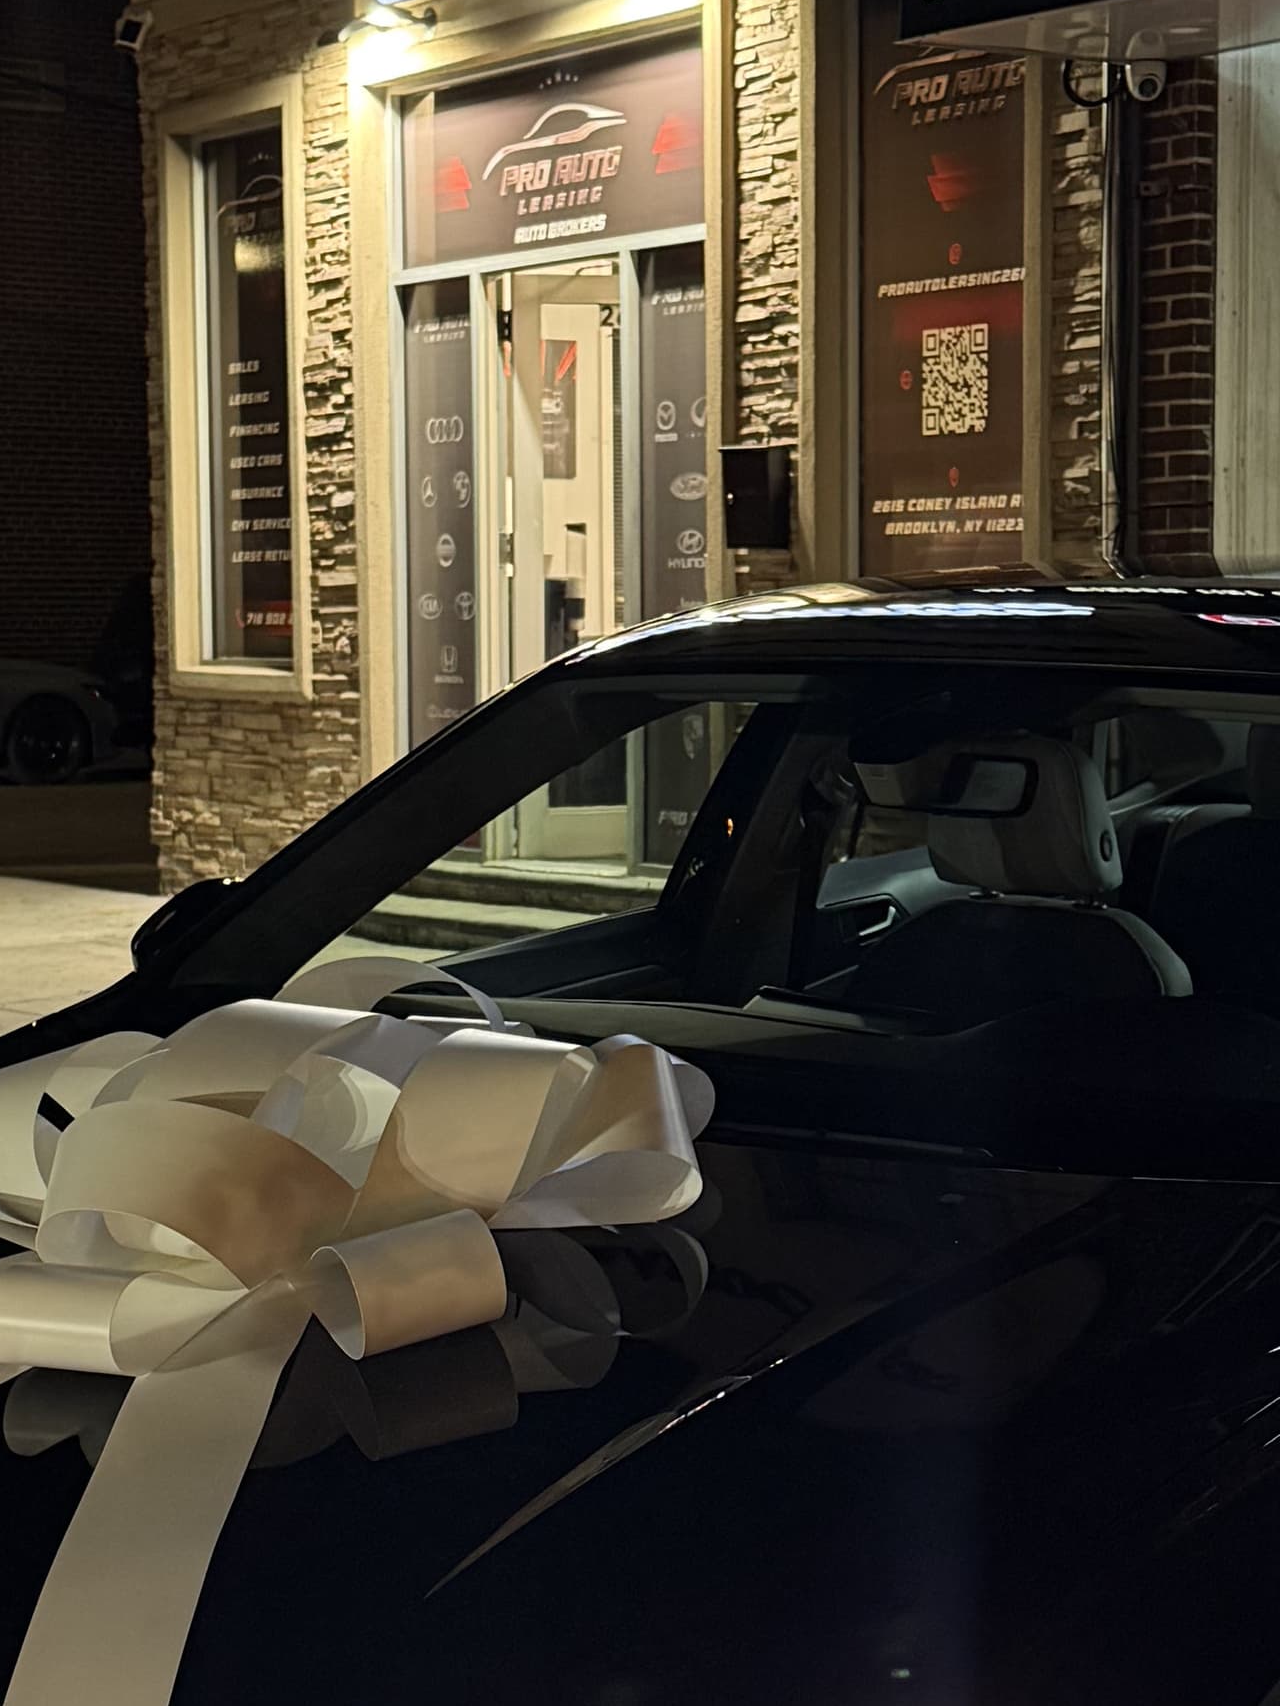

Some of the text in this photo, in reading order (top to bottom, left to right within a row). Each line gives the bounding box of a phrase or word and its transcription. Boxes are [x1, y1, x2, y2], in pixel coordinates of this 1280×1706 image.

[891, 57, 1026, 110] PRO AUTO
[911, 94, 1007, 126] LEASING
[500, 146, 623, 196] PRO AUTO
[517, 186, 604, 215] LEASING
[514, 213, 608, 244] AUTO BROKERS
[872, 499, 905, 514] 2615
[907, 497, 953, 512] CONEY
[955, 494, 1008, 510] ISLAND
[964, 519, 983, 533] NY
